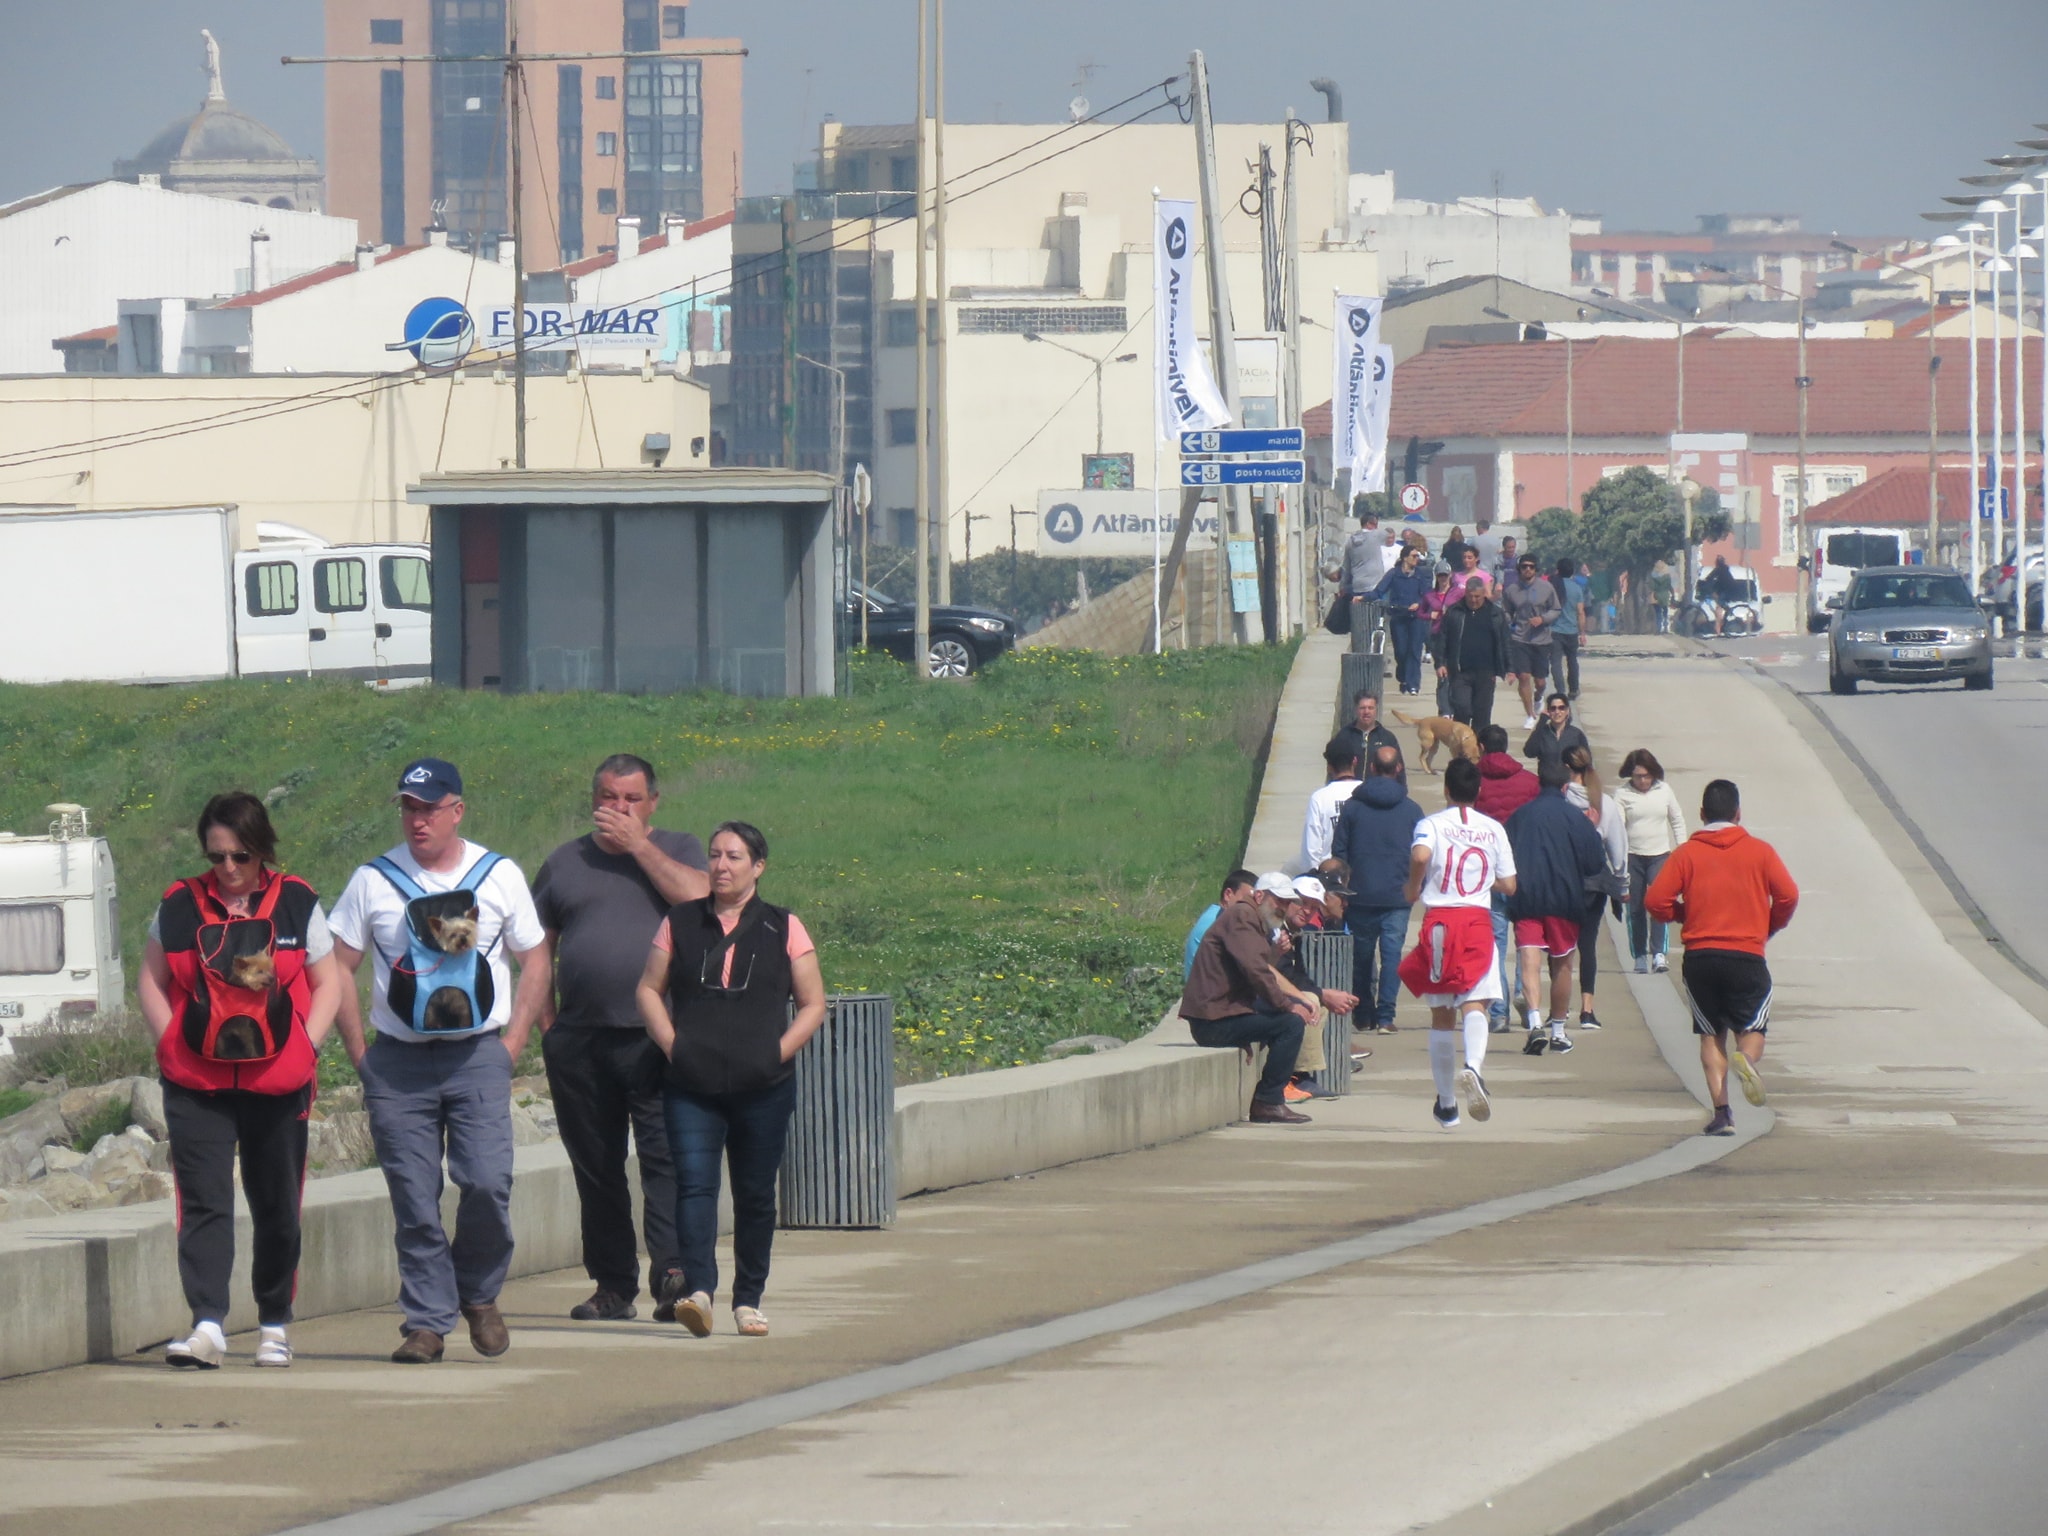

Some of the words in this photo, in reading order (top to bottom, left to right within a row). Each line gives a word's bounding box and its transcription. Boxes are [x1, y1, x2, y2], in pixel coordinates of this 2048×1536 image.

[492, 309, 659, 337] FOR-MAR
[1267, 437, 1299, 445] marina
[1235, 468, 1262, 478] posto
[1444, 827, 1496, 844] GUSTAVO
[1440, 845, 1489, 898] 10
